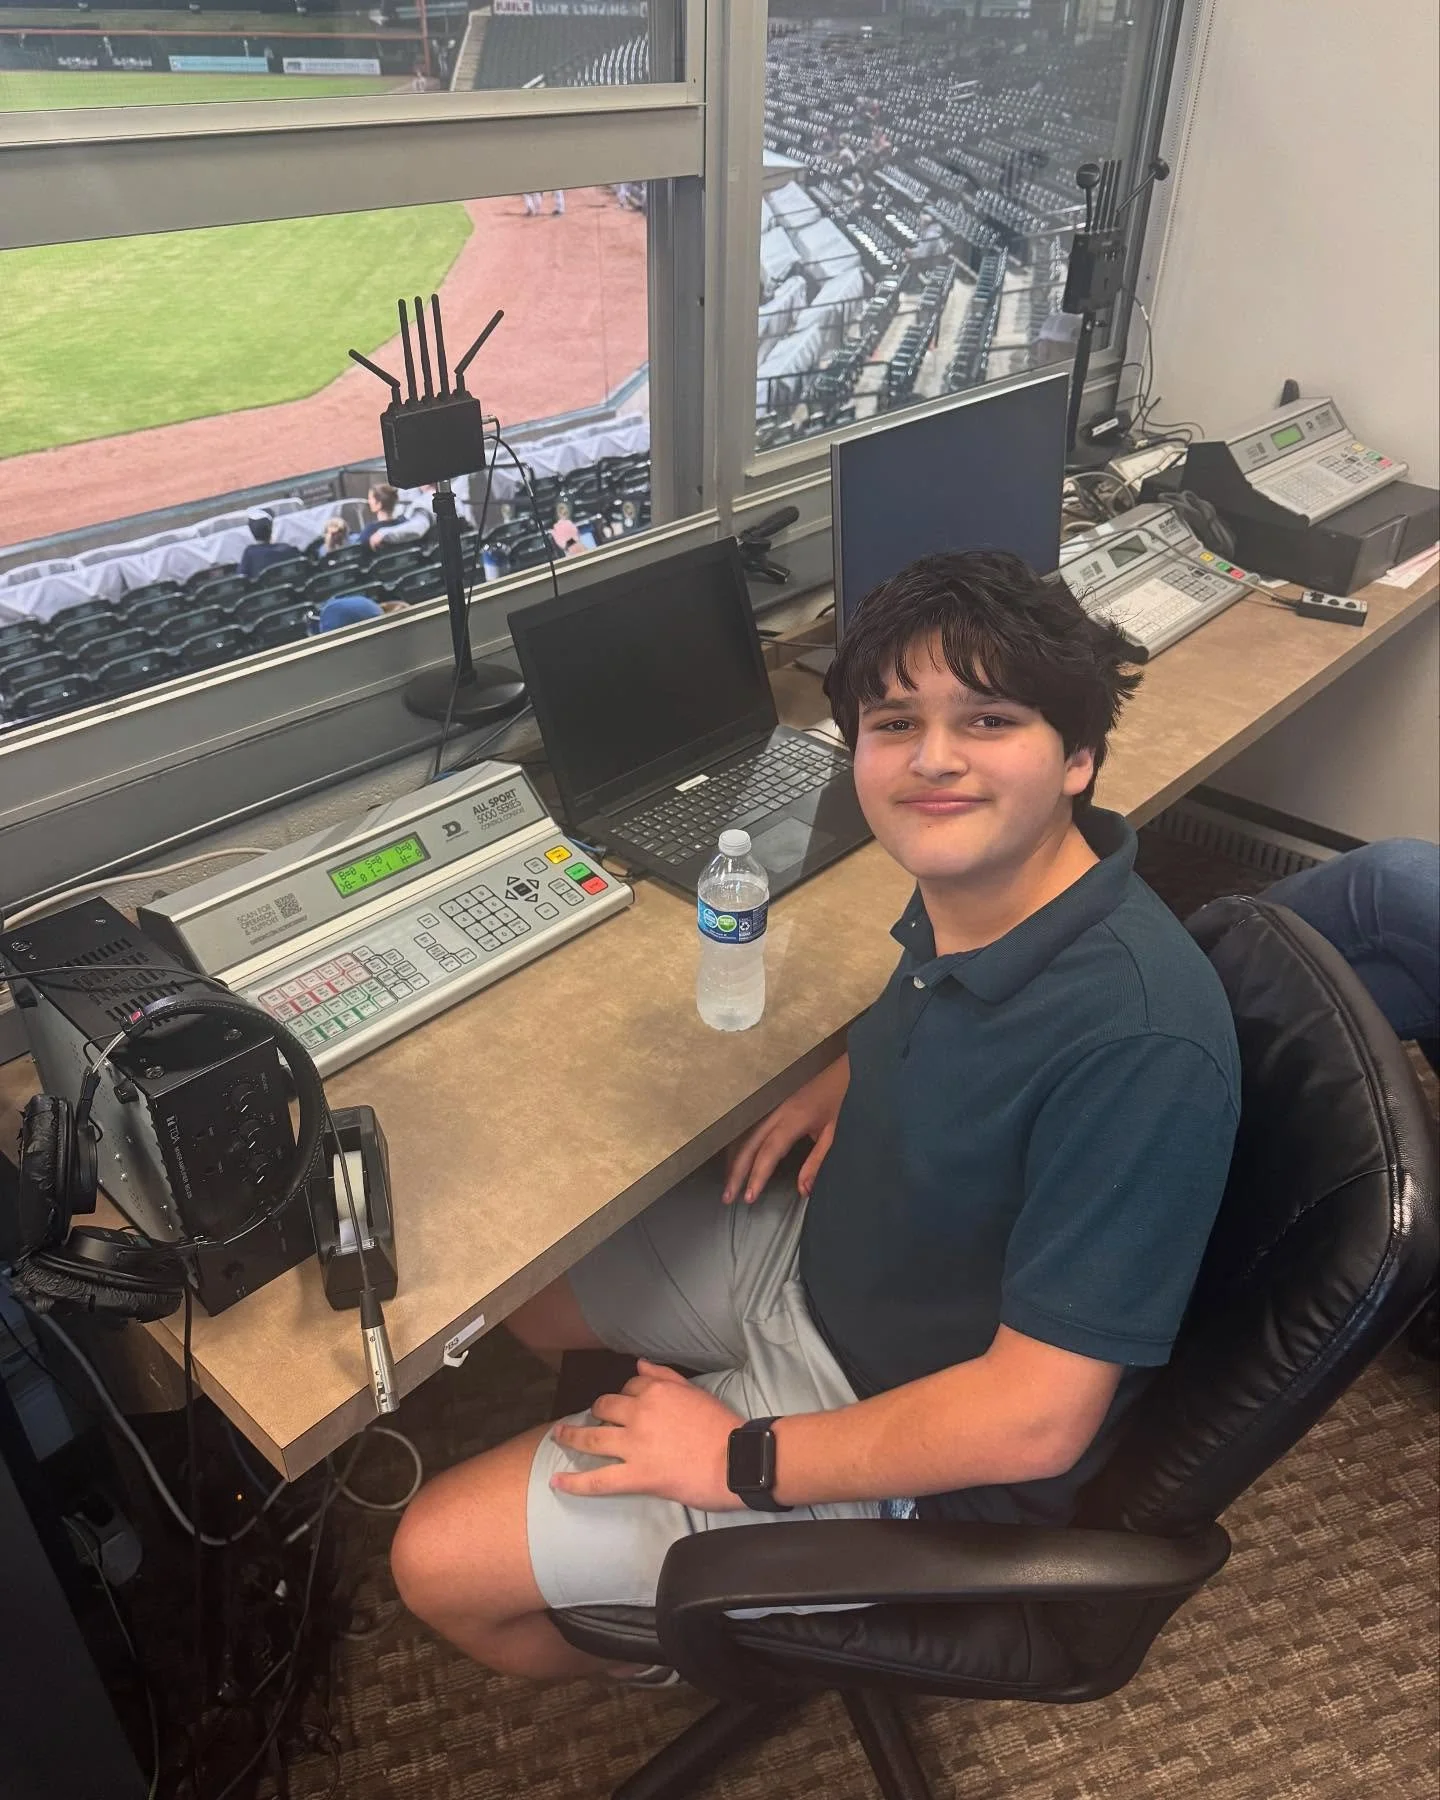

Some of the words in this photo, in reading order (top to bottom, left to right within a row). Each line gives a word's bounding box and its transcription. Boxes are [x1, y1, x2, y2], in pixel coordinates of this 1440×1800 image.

[472, 802, 489, 815] ALL
[488, 788, 517, 807] SPORT
[476, 809, 498, 825] 5000
[496, 798, 522, 815] SERIES
[237, 910, 258, 921] SCAN
[257, 903, 271, 914] FOR
[241, 909, 277, 929] OPERATION
[250, 915, 279, 932] SUPPORT
